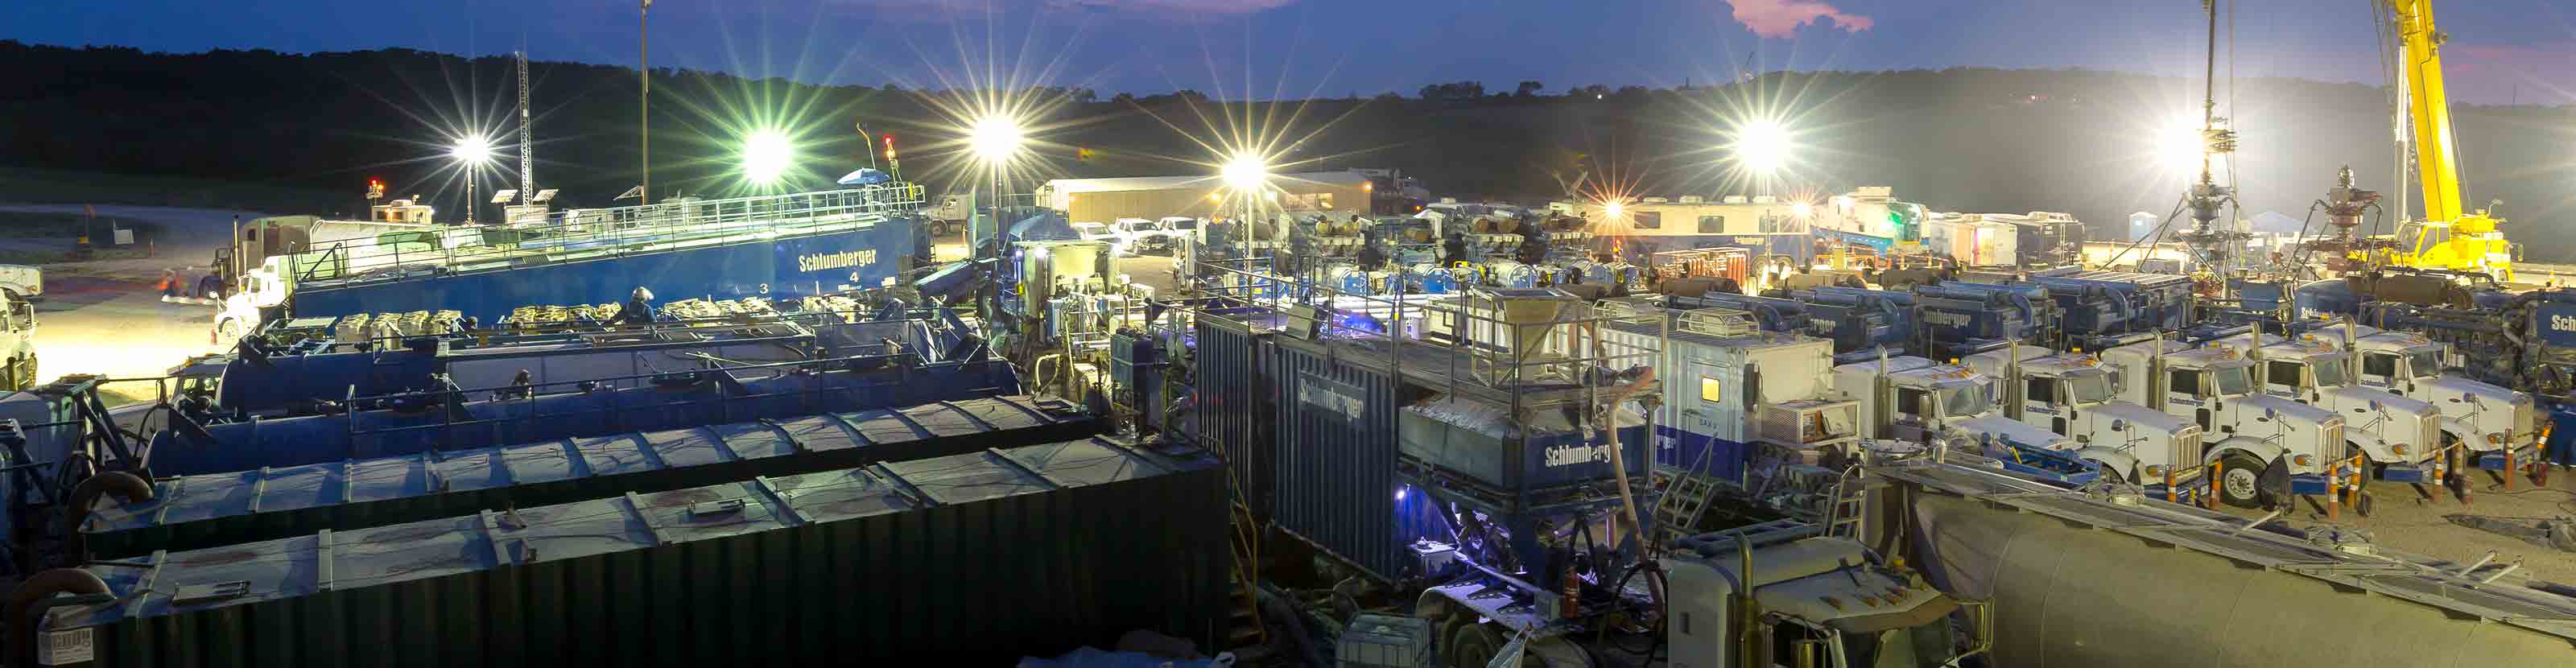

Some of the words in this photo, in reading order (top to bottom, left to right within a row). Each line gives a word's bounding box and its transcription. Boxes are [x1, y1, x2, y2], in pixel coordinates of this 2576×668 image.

[798, 249, 877, 273] Schlumberger
[849, 271, 860, 283] 4
[759, 282, 770, 295] 3
